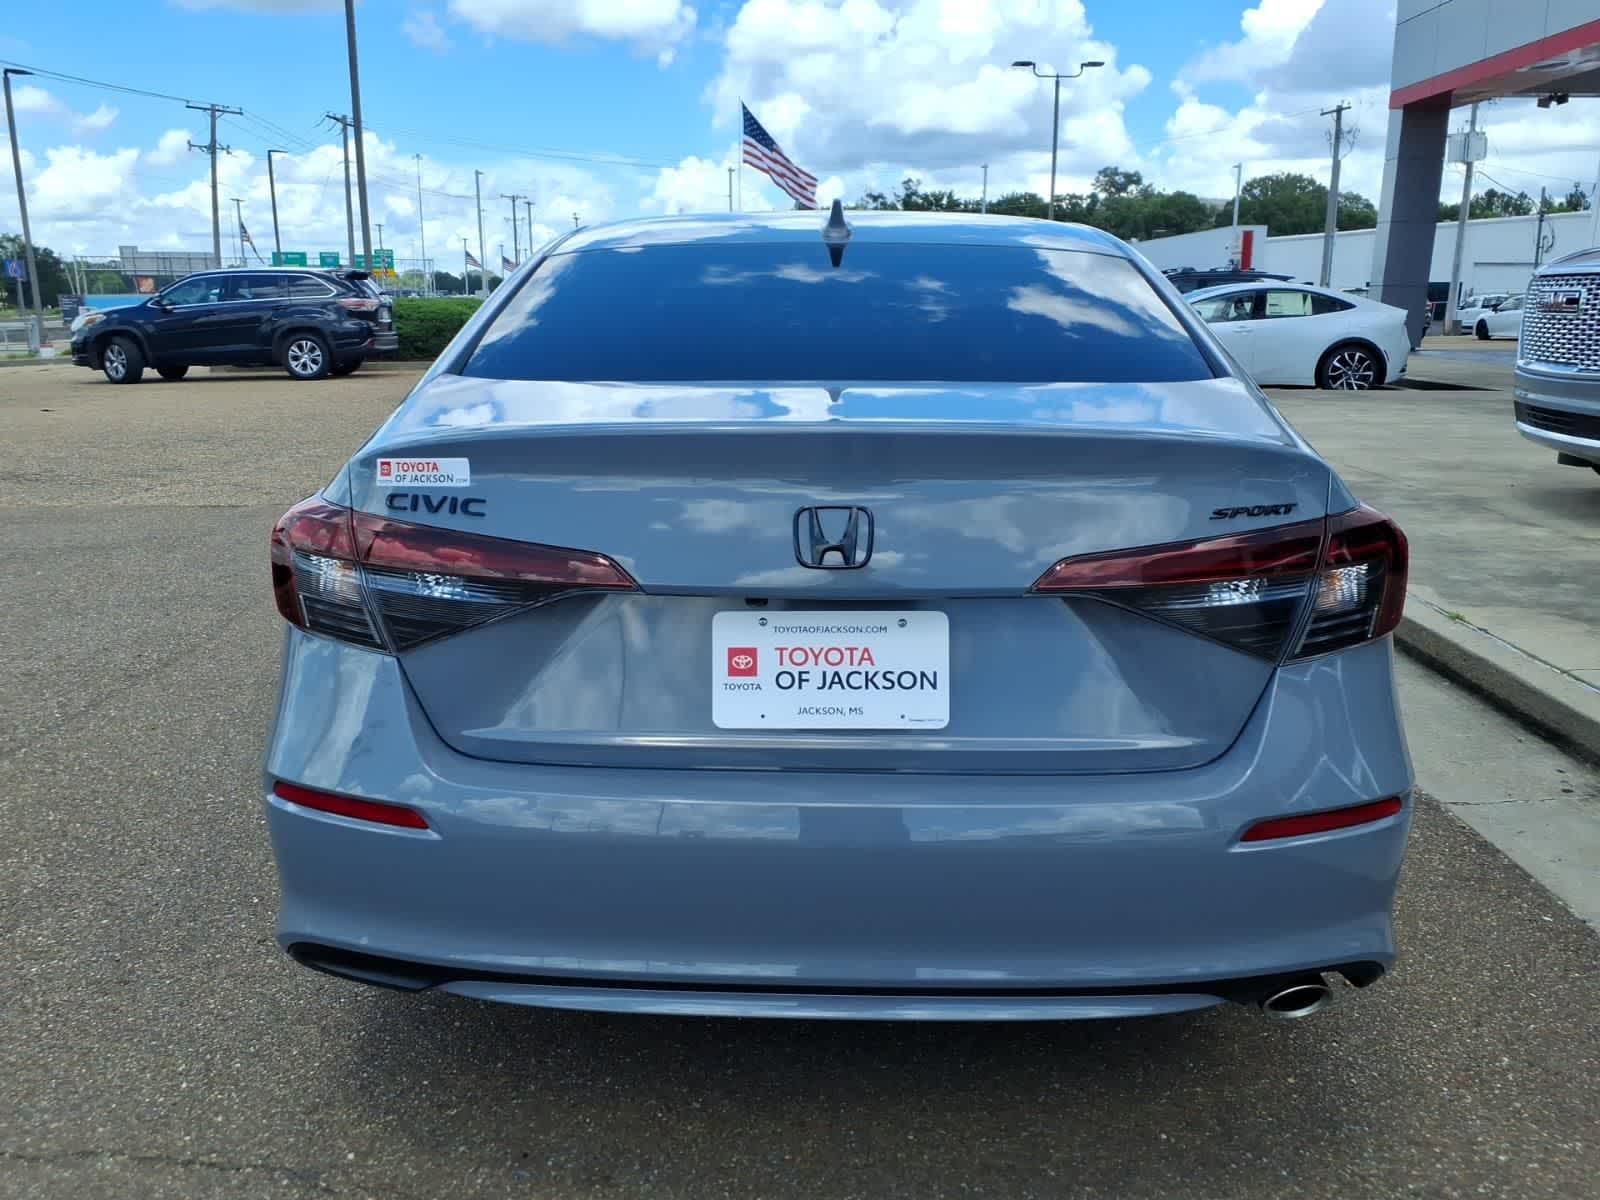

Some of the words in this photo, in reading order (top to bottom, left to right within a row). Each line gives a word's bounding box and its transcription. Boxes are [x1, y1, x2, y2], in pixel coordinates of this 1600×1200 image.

[395, 462, 439, 473] TOYOTA
[395, 474, 408, 483] OF
[409, 474, 454, 483] JACKSON
[385, 492, 487, 517] CIVIC
[1209, 502, 1298, 520] SPORT
[774, 625, 888, 634] TOYOTAOFJACKSON.COM
[774, 647, 875, 667] TOYOTA
[775, 670, 811, 691] OF
[816, 670, 938, 691] JACKSON
[723, 683, 762, 691] TOYOTA
[797, 707, 847, 717] JACKSON,
[849, 707, 864, 716] MS
